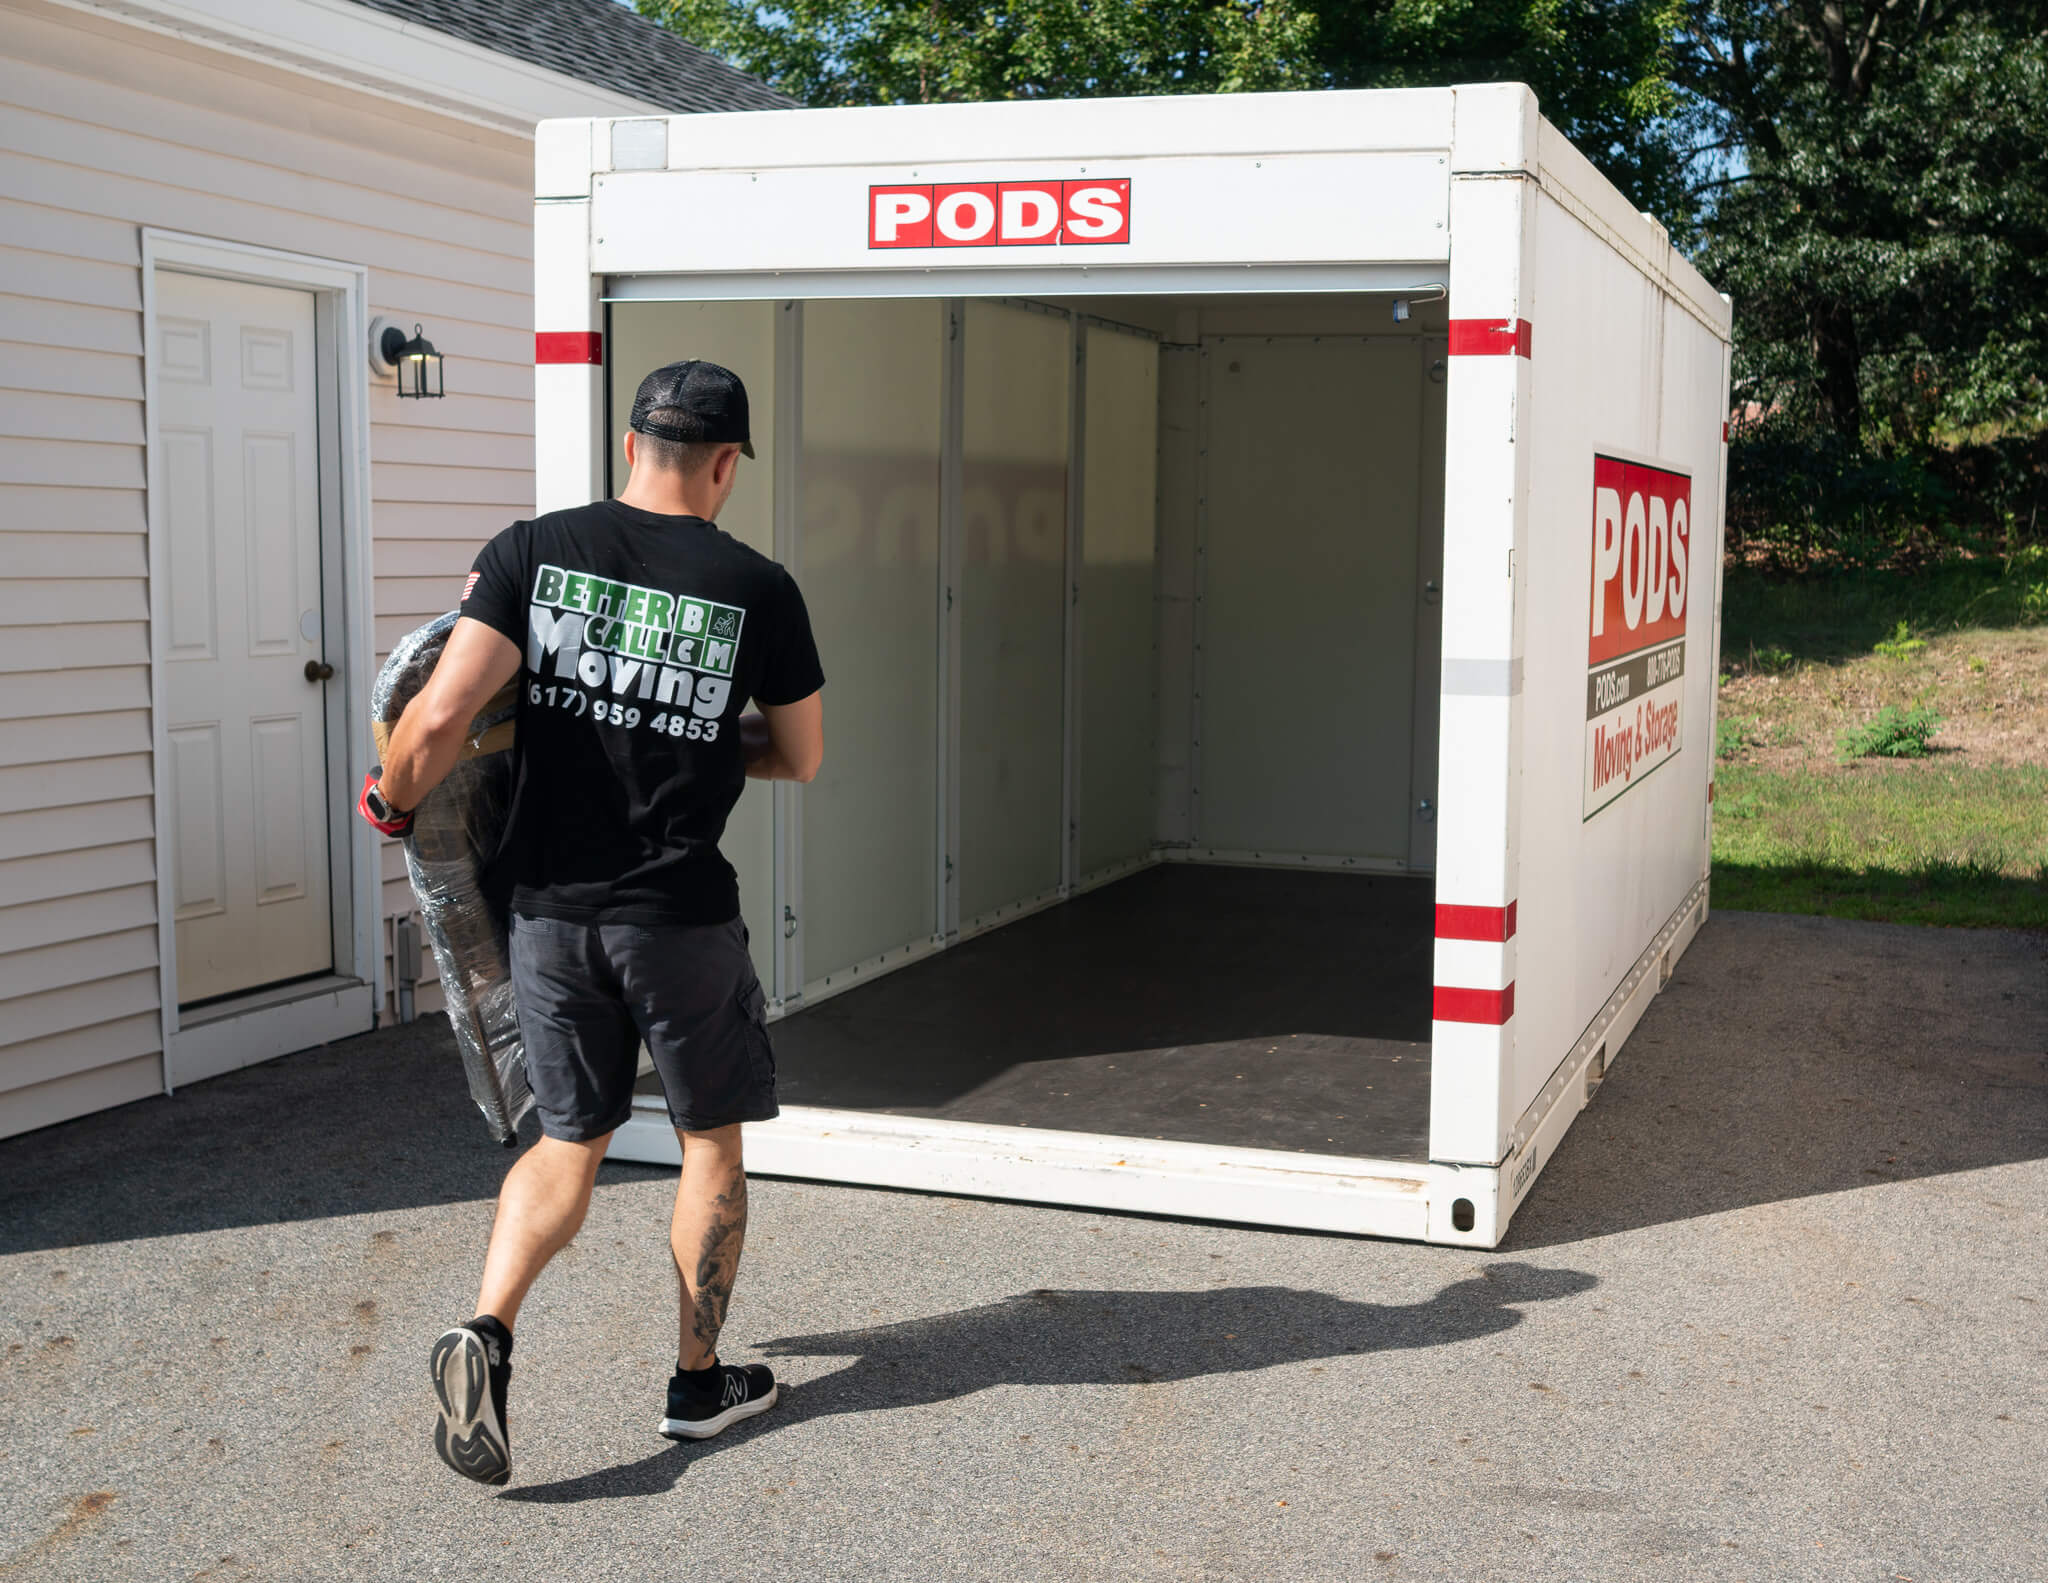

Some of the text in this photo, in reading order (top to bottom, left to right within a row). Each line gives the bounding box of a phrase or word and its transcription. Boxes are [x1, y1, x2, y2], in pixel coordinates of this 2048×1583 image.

[875, 187, 1124, 242] PODS
[1592, 487, 1689, 638] PODS
[532, 564, 675, 633] BETTER
[681, 604, 704, 633] B
[528, 604, 733, 719] Moving
[584, 614, 667, 664] CALL
[1595, 671, 1630, 713] PODS.com
[593, 700, 642, 728] 959
[650, 712, 720, 743] 4853
[1592, 699, 1678, 792] Moving & Storage
